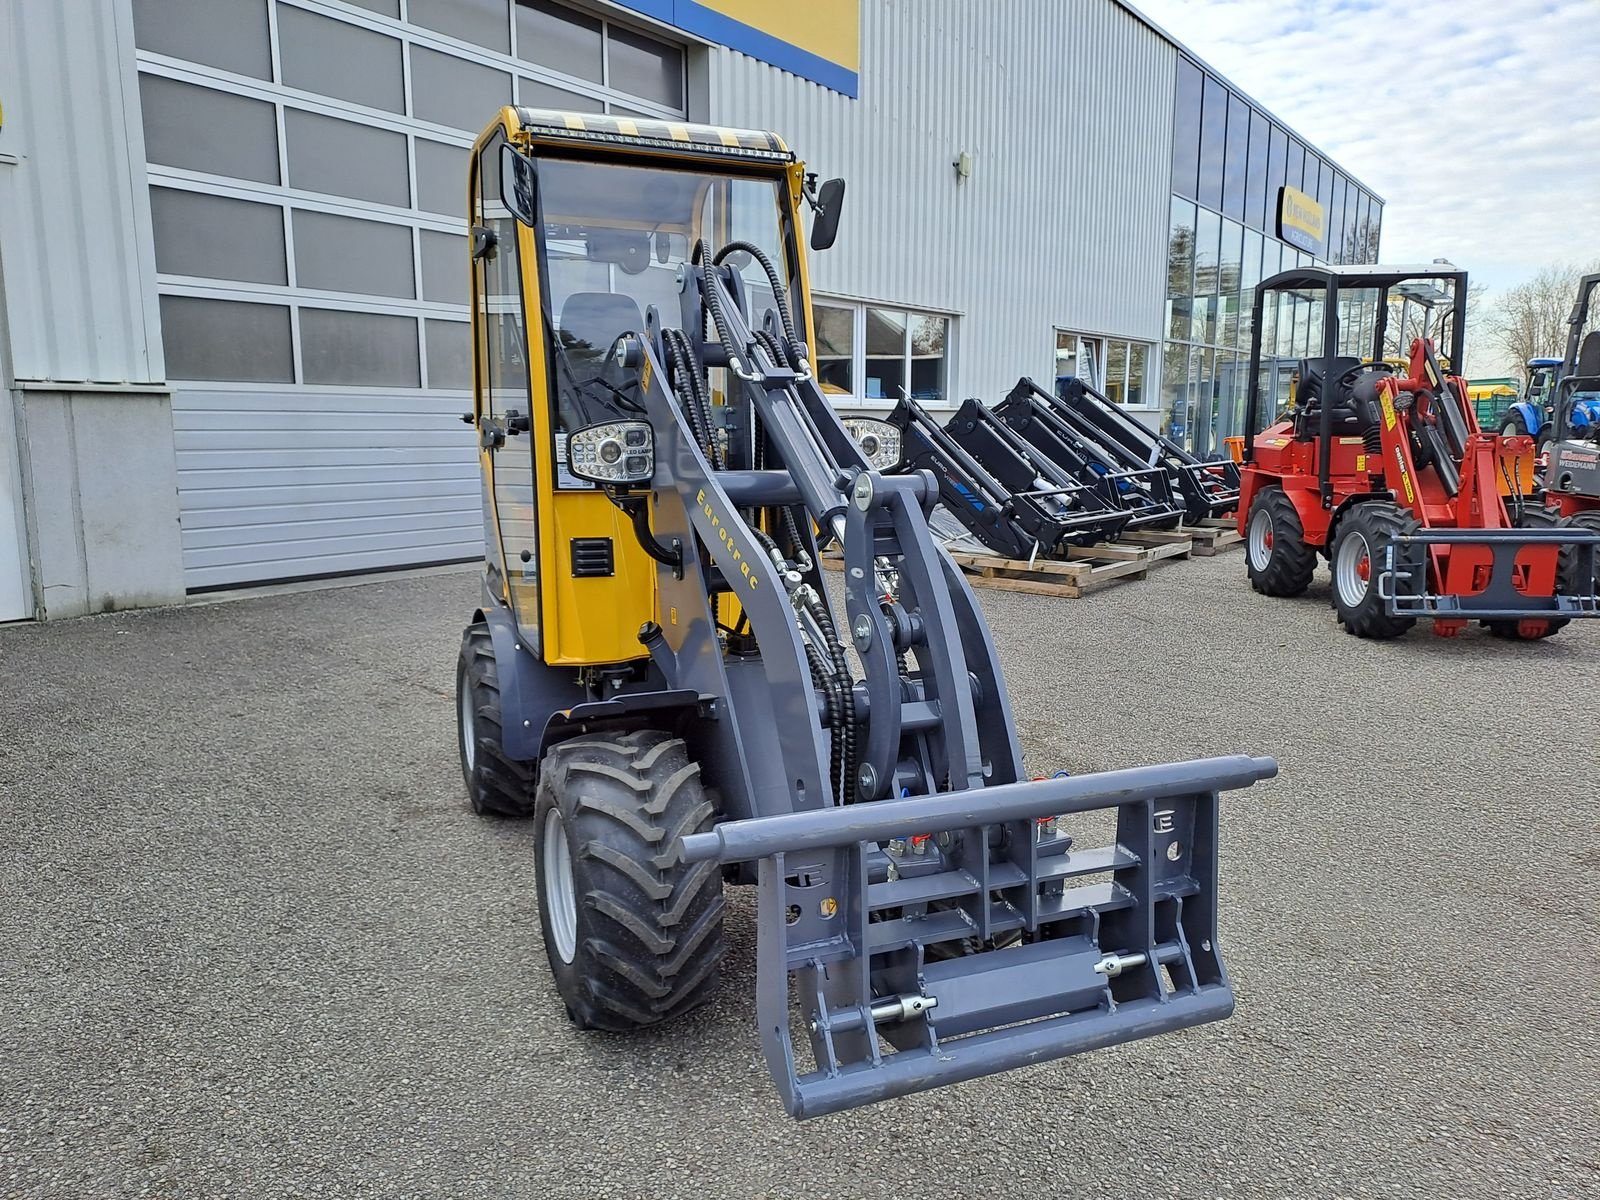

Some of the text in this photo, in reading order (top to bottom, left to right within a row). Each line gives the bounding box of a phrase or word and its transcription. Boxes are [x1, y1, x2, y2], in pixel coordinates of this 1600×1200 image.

[930, 455, 948, 472] EURO
[1559, 459, 1597, 470] WEIDEMANN
[696, 488, 758, 590] Eurotrac
